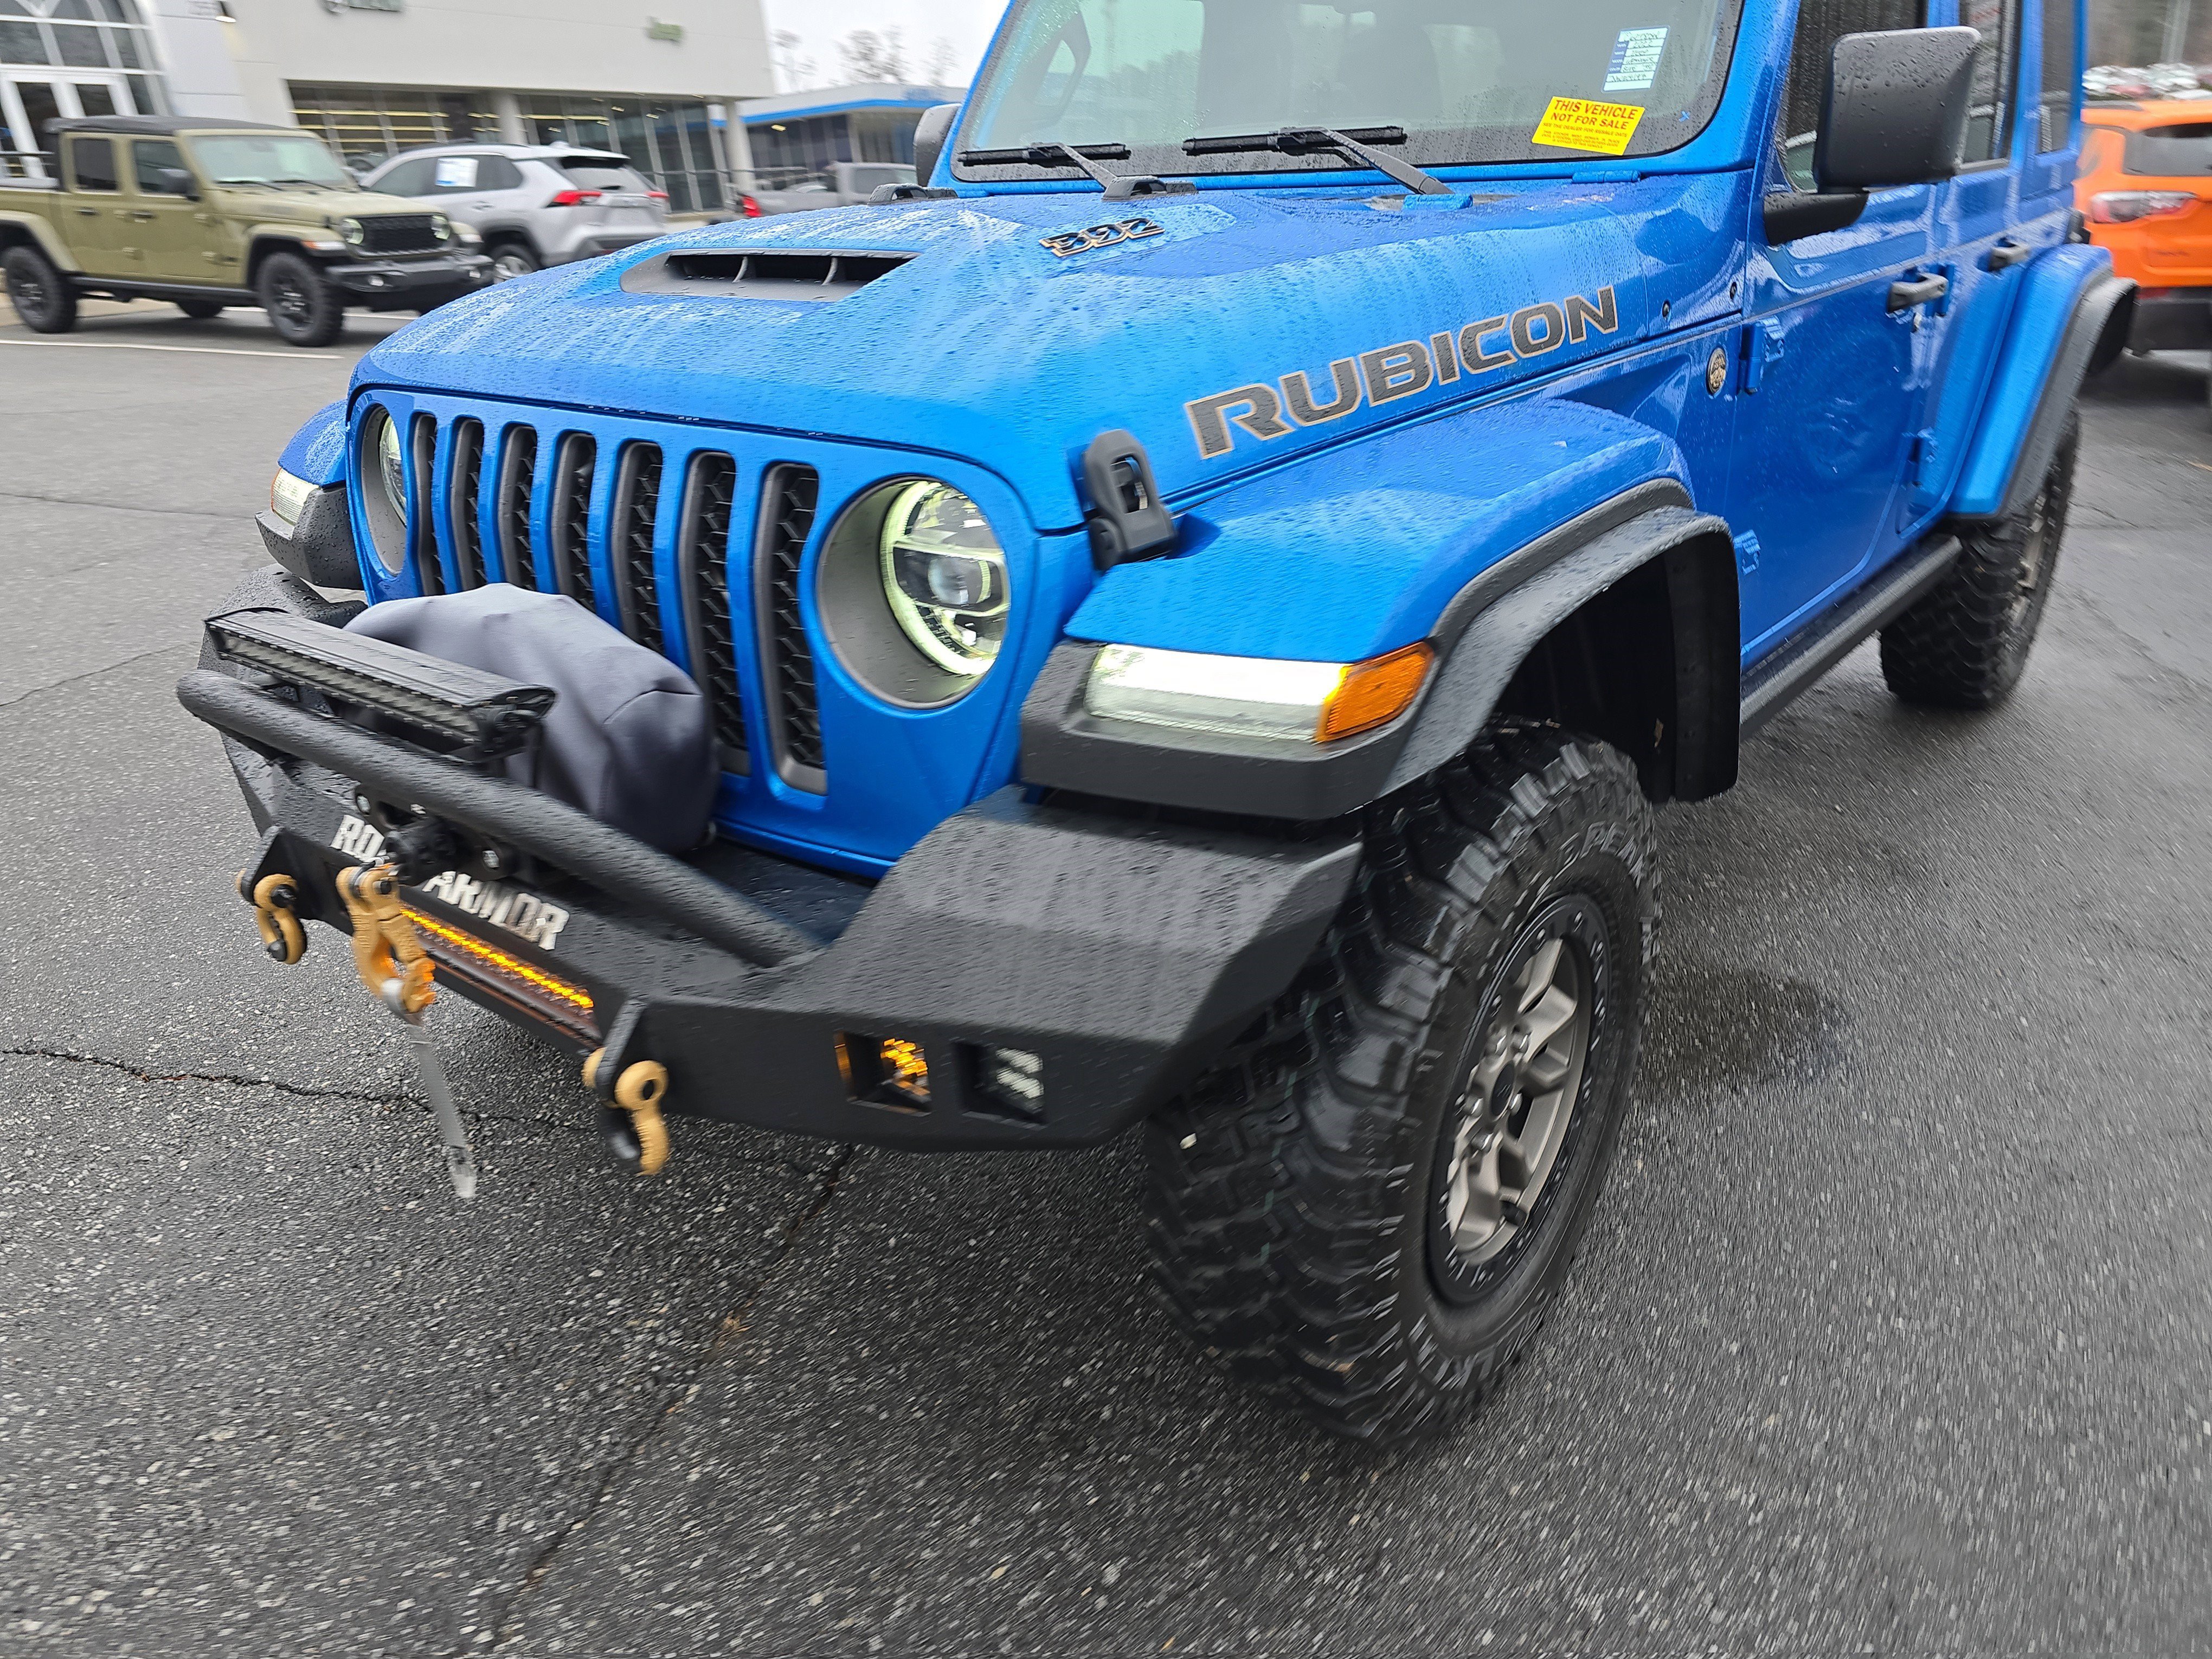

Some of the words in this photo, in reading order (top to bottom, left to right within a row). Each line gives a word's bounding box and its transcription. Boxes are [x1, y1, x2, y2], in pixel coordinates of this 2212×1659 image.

[1551, 112, 1574, 122] NOT
[1574, 115, 1598, 126] FOR
[1599, 119, 1629, 130] SALE
[1554, 99, 1582, 112] THIS
[1585, 103, 1638, 120] VEHICLE
[1184, 286, 1618, 459] RUBICON
[329, 814, 387, 863] RO
[422, 871, 570, 951] ARMOR
